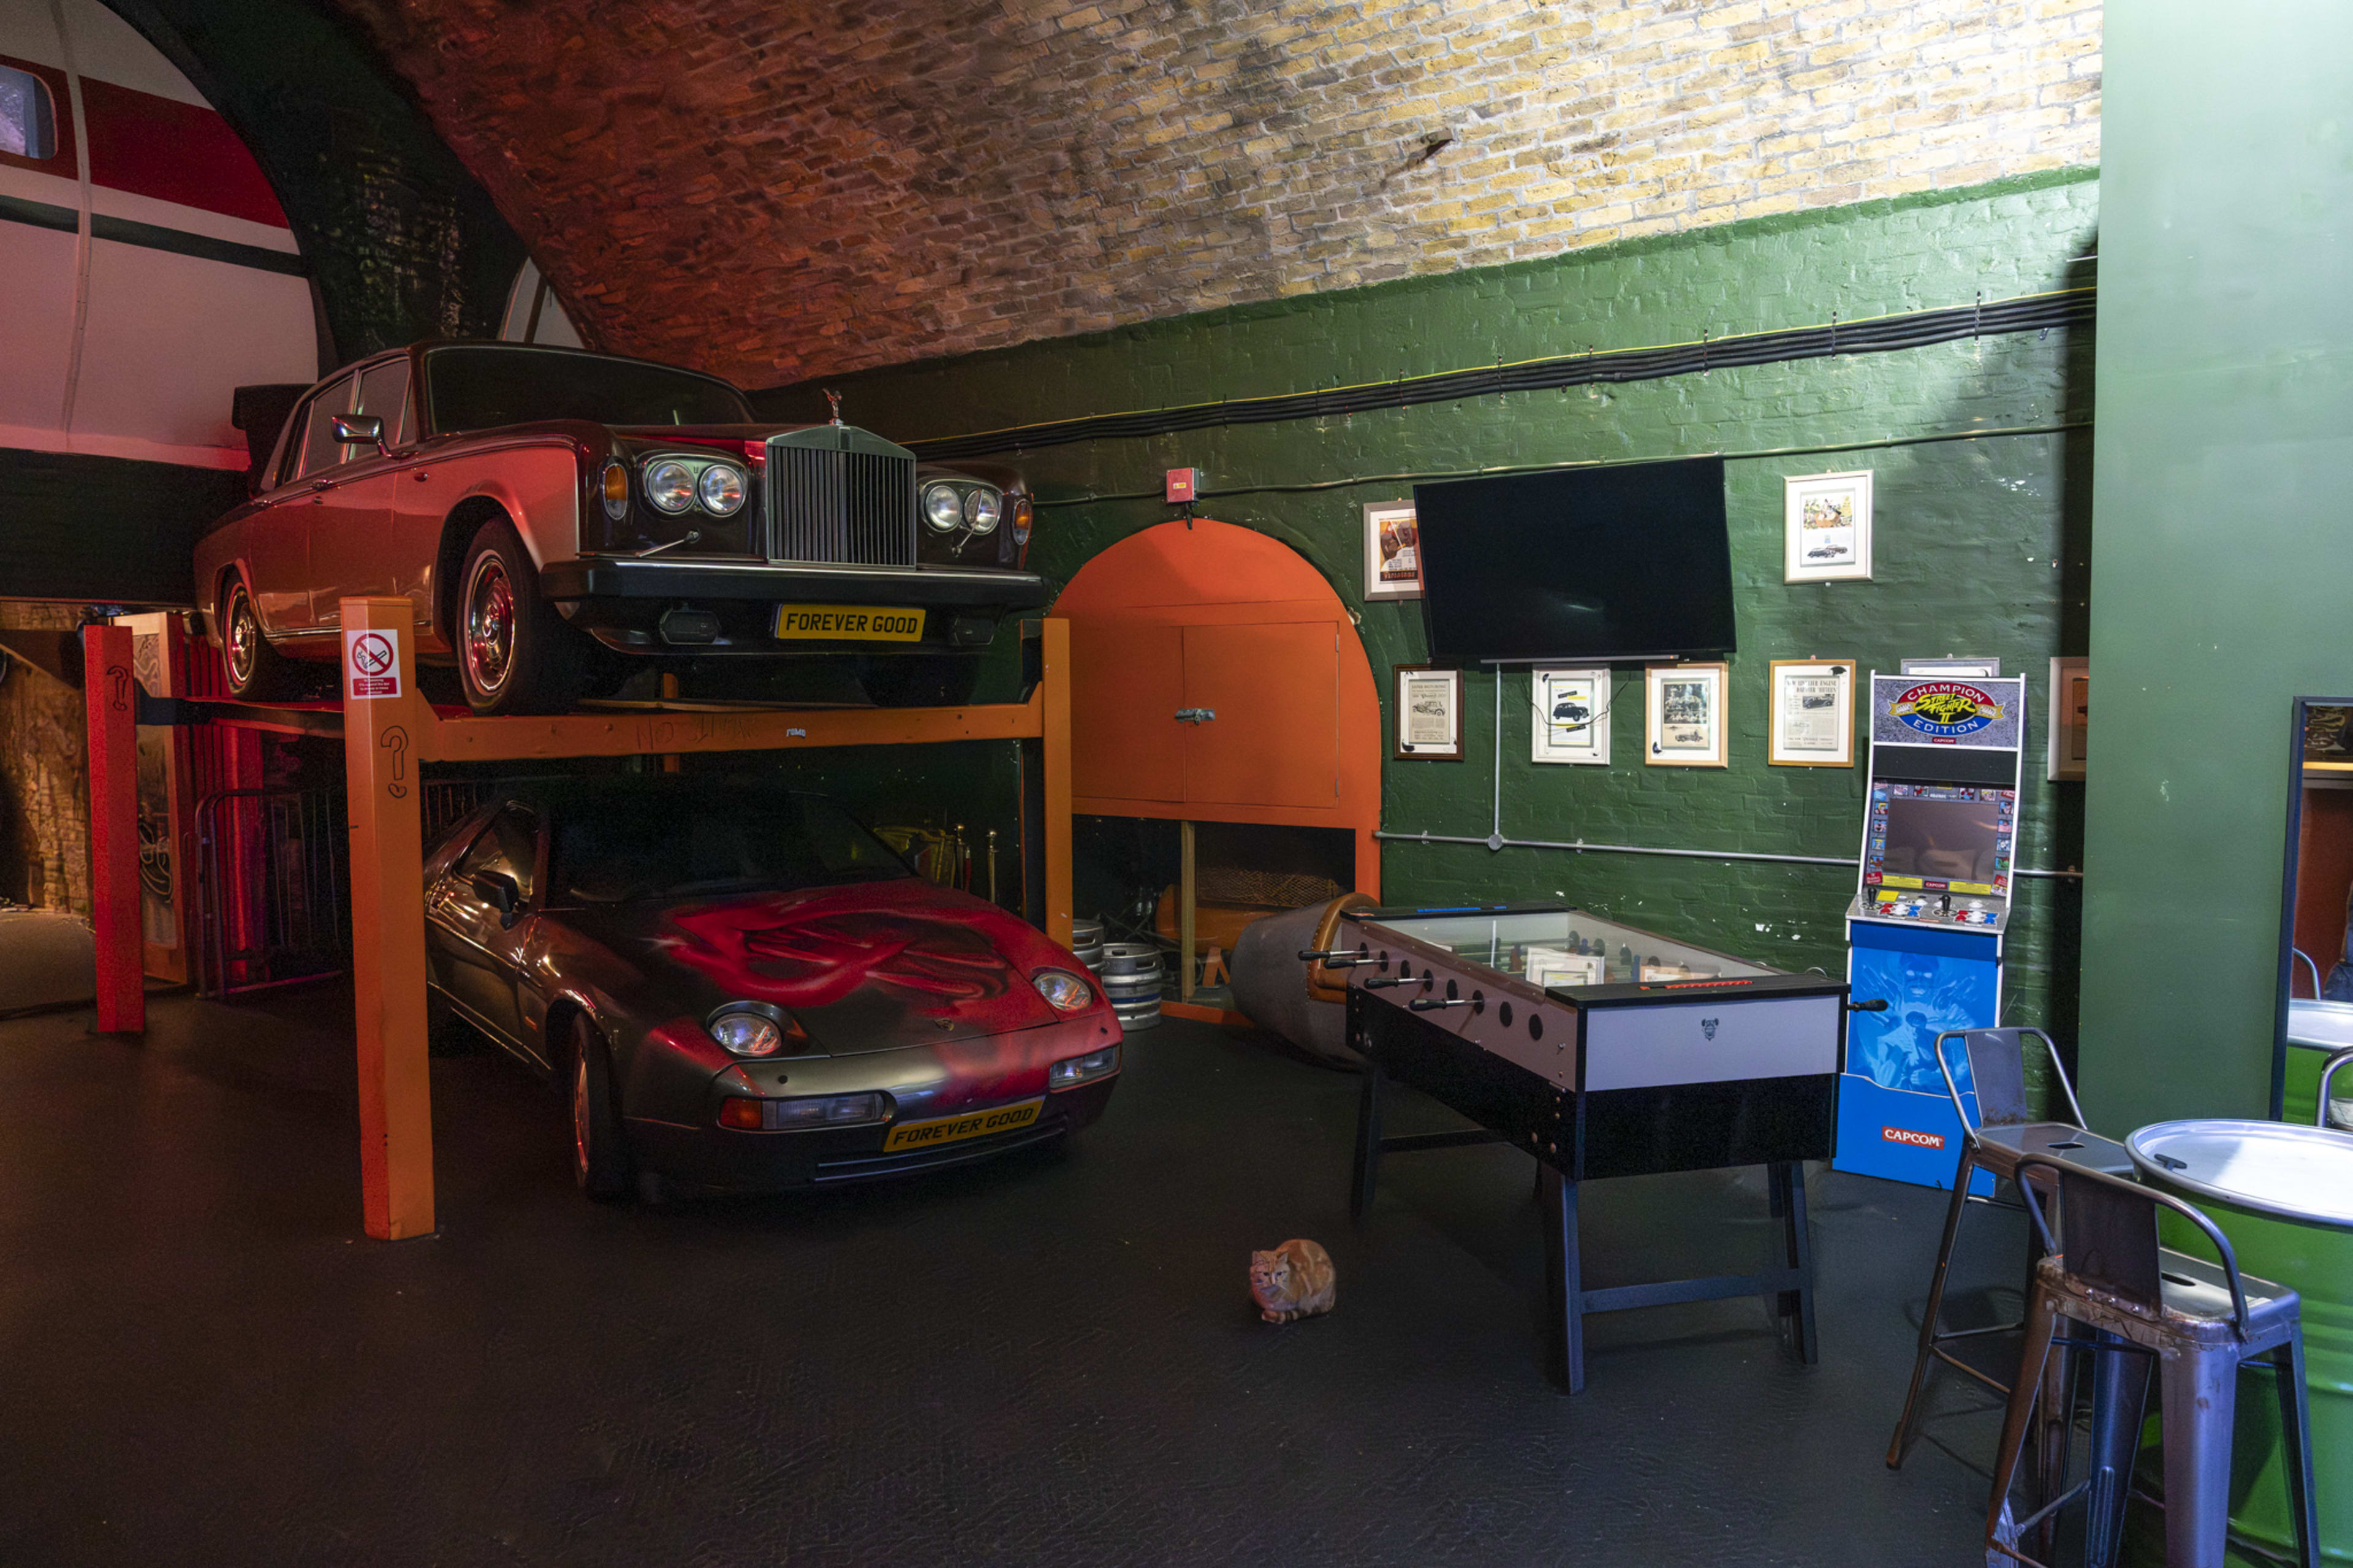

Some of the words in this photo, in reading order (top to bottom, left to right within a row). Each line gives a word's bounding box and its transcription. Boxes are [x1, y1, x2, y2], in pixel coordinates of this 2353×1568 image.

[786, 613, 868, 632] FOREVER
[872, 615, 918, 634] GOOD
[1907, 684, 1985, 703] CHAMPION
[1915, 693, 1956, 711] STREET
[1923, 697, 1976, 714] FIGHTER
[1913, 719, 1979, 734] EDITION
[1936, 711, 1957, 724] II
[893, 1118, 983, 1145] FOREVER
[986, 1107, 1034, 1129] GOOD
[1885, 1129, 1940, 1147] CAPCOM
